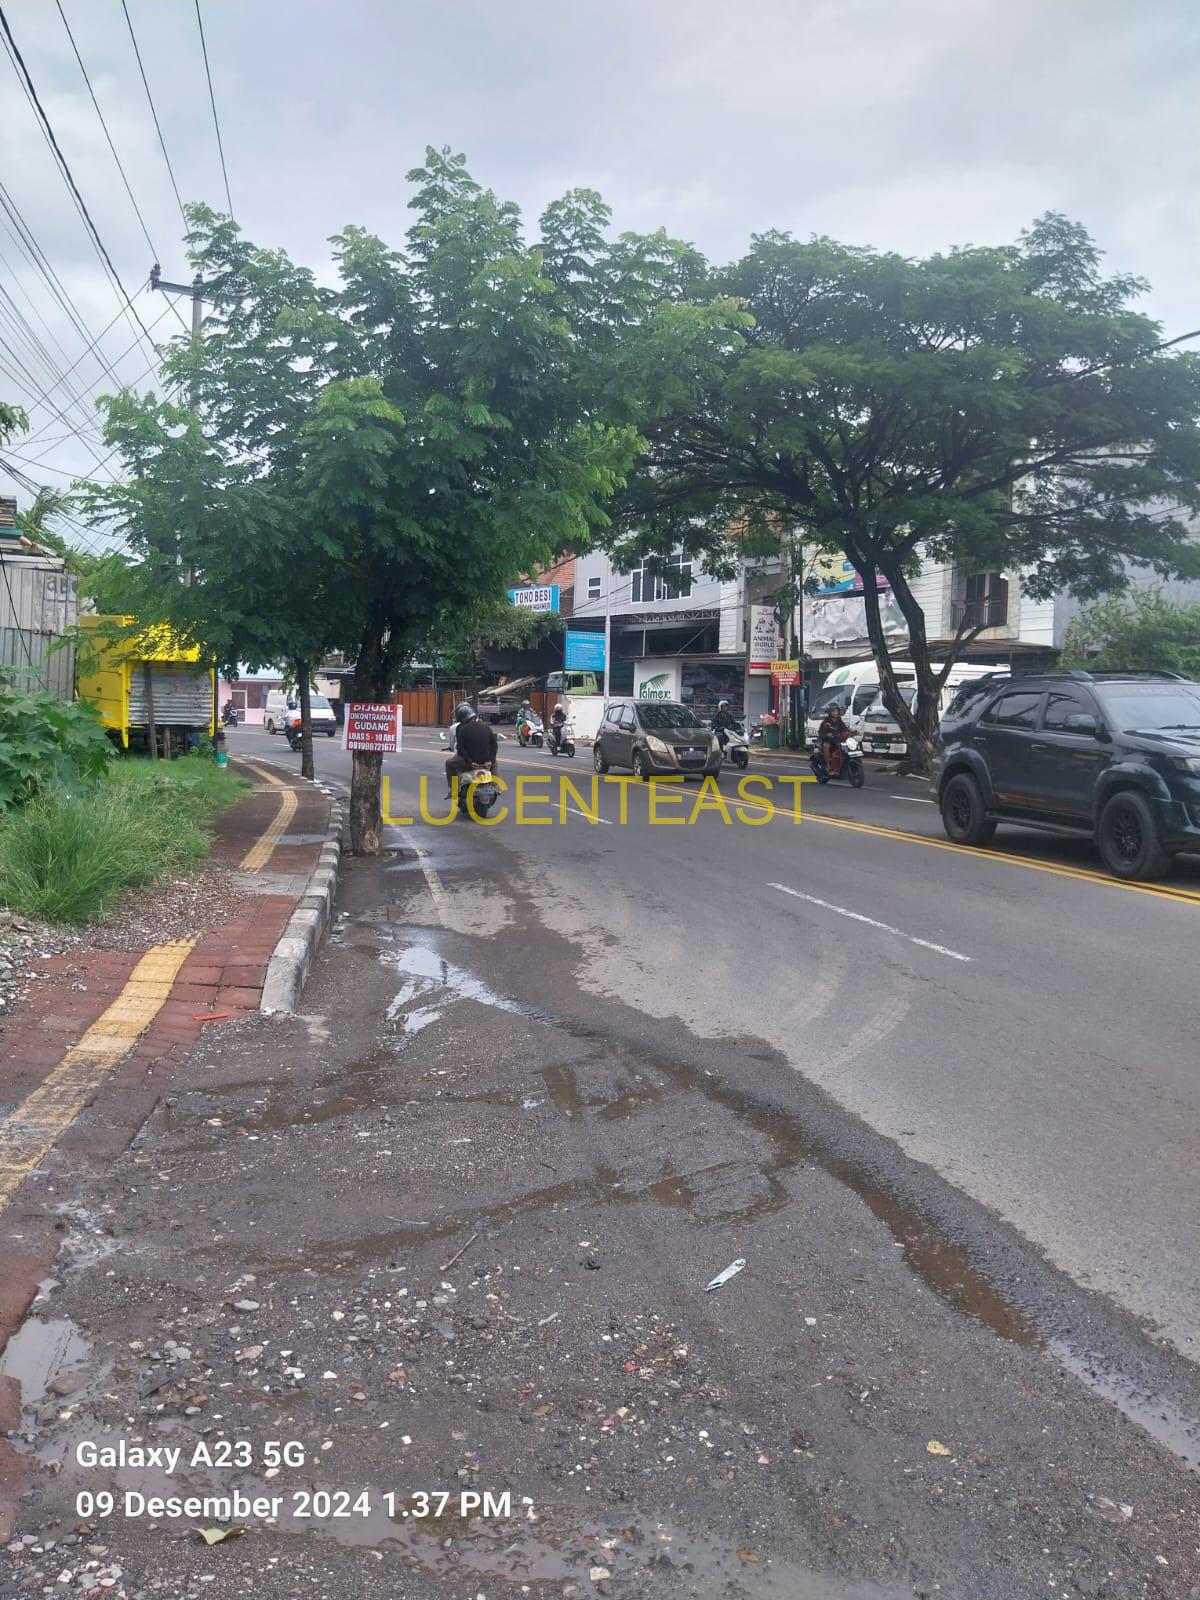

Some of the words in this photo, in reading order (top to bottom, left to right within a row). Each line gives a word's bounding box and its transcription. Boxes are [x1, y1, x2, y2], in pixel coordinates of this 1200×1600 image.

[515, 591, 533, 604] TOKO
[534, 589, 551, 601] BESI
[353, 704, 393, 713] DIJUAL
[350, 712, 396, 721] DIKONTRAKKAN
[354, 721, 389, 731] GUDANG
[349, 732, 364, 740] LUAS
[375, 733, 382, 741] 10
[383, 734, 396, 742] ARE
